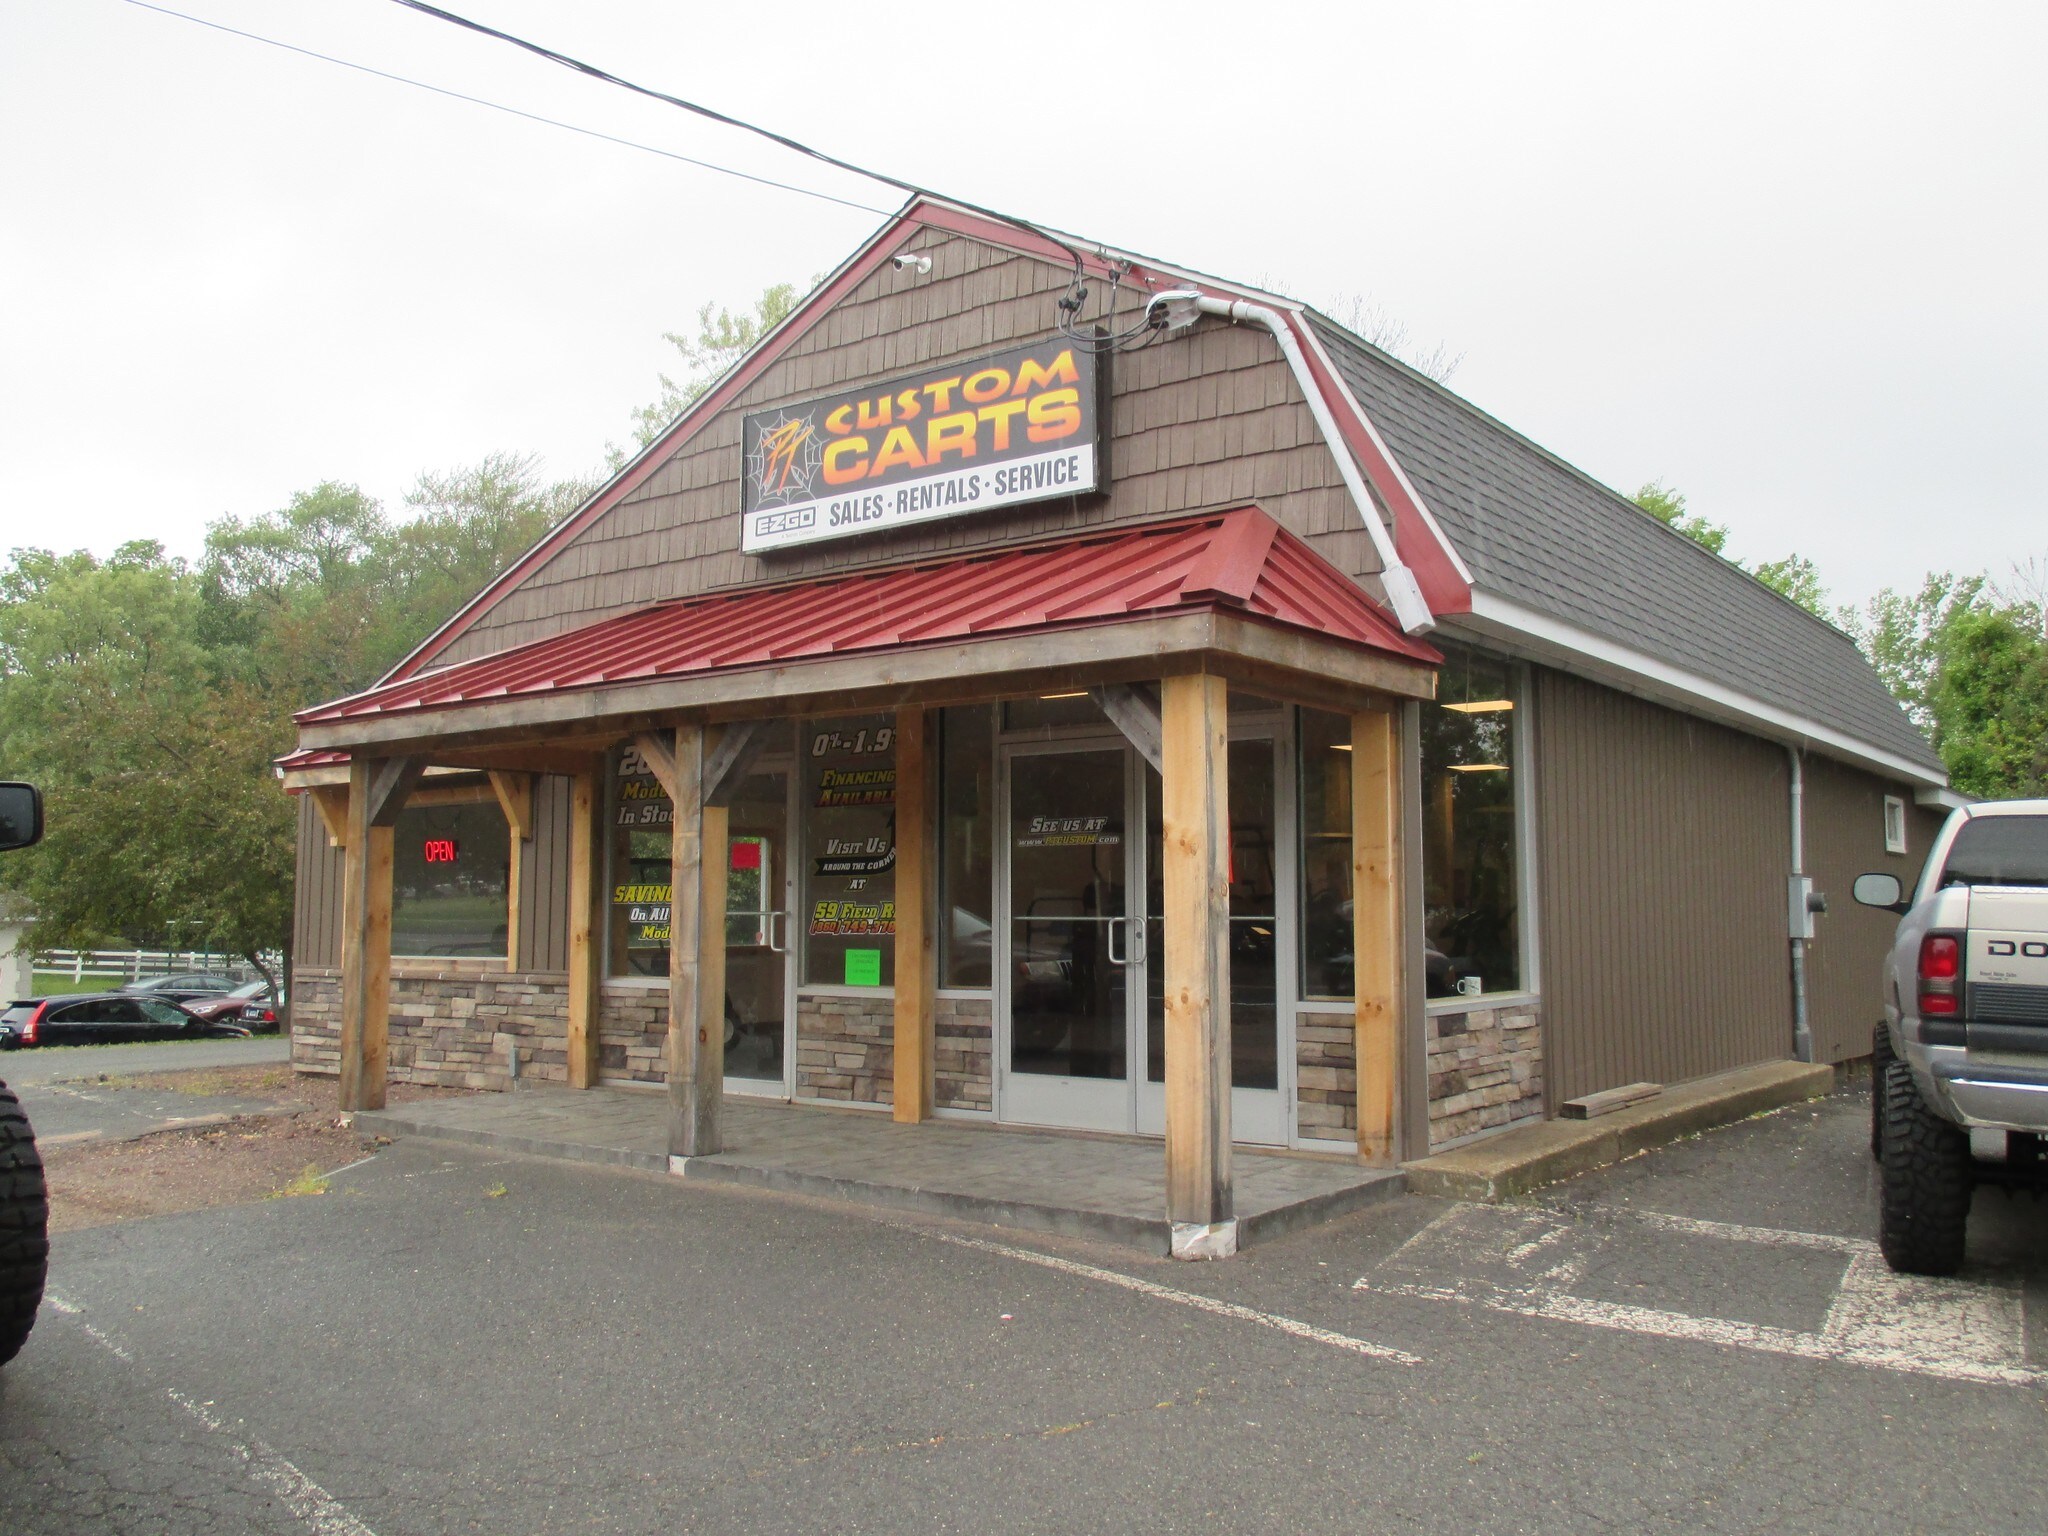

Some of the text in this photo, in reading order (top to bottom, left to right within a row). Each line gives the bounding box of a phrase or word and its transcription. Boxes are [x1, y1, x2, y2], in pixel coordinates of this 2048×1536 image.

[825, 350, 1081, 435] CUSTOM
[822, 387, 1082, 486] CARTS
[829, 455, 1079, 527] SALES RENTALS SERVICE
[756, 507, 816, 536] EZGO
[617, 806, 636, 825] In
[1030, 817, 1105, 833] SEE US AT
[425, 841, 454, 862] OPEN
[826, 837, 887, 855] VISIT US
[823, 862, 851, 871] AROUND
[852, 862, 866, 871] THE
[850, 879, 867, 890] AT
[630, 907, 670, 921] On All
[815, 902, 896, 919] 59 FIELD R
